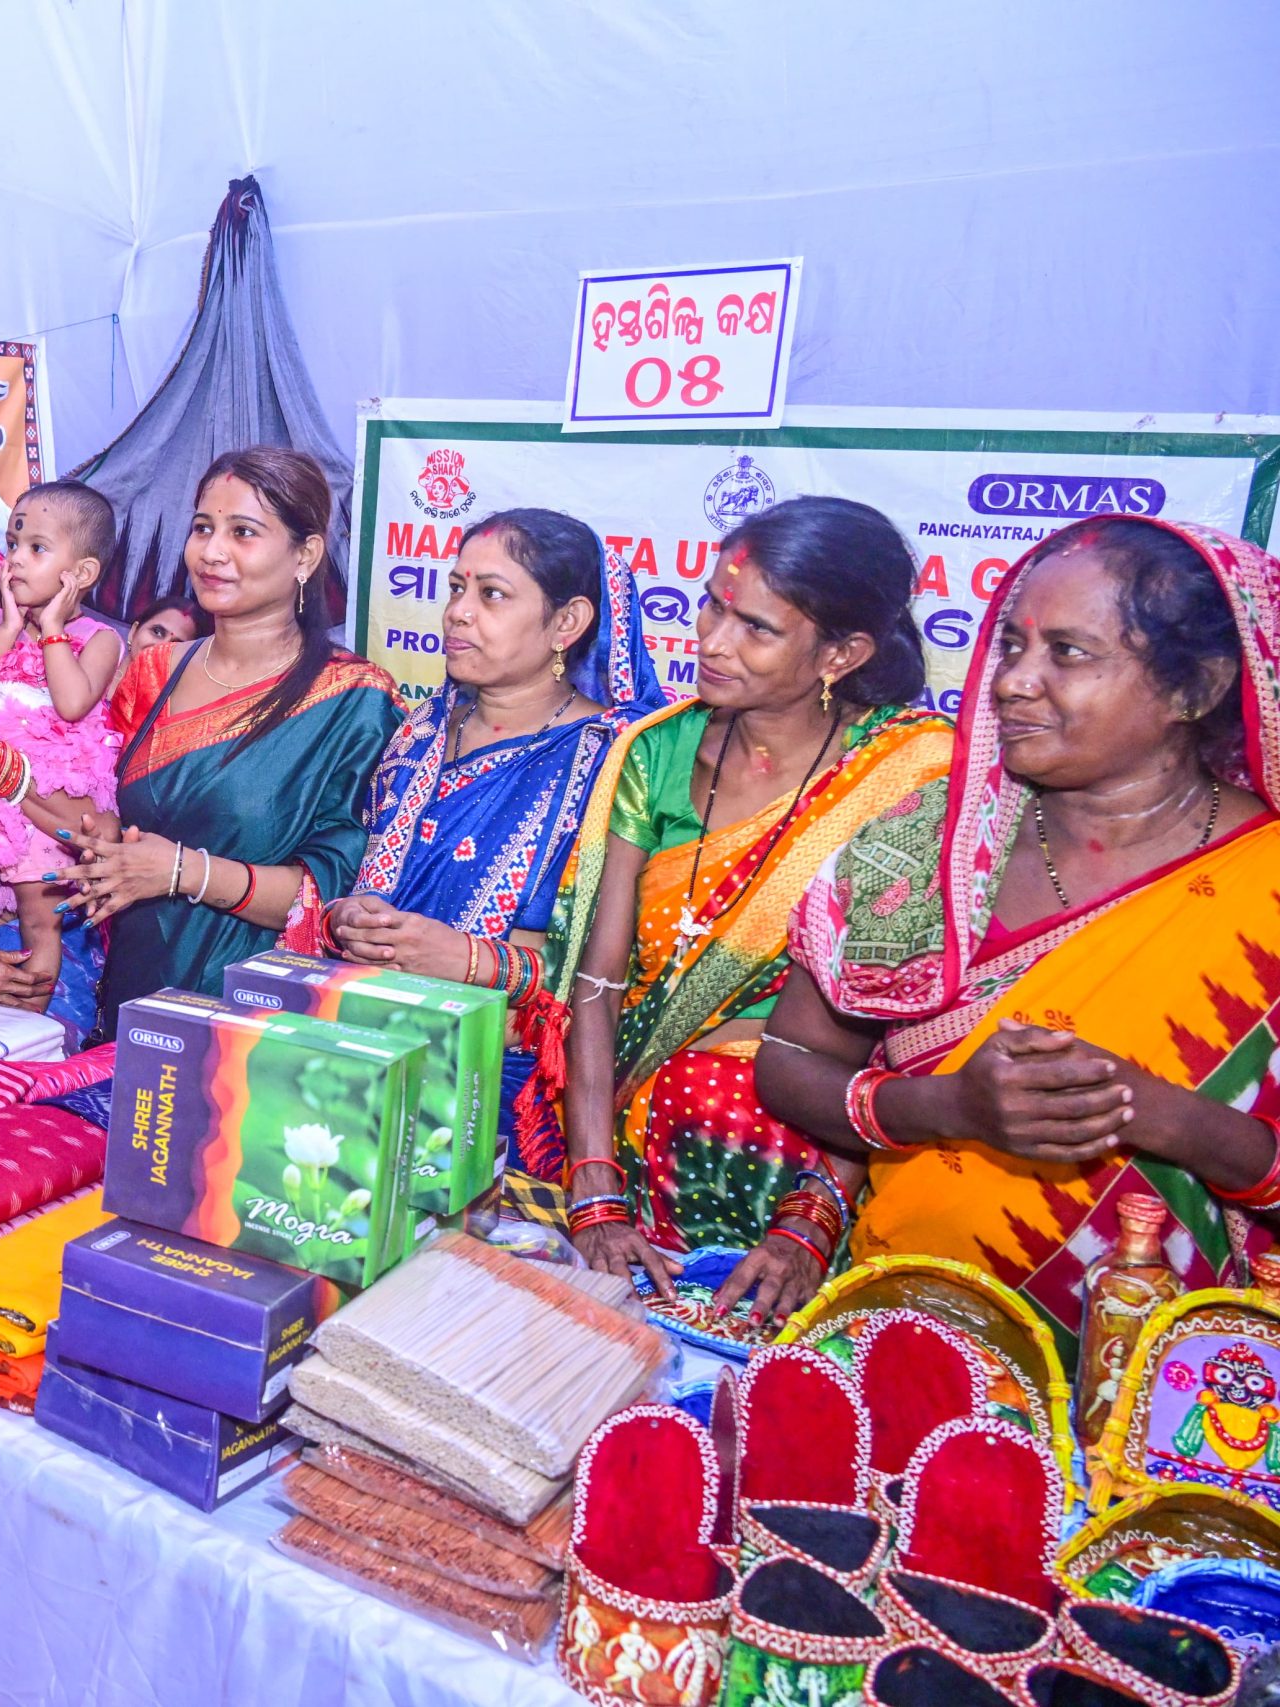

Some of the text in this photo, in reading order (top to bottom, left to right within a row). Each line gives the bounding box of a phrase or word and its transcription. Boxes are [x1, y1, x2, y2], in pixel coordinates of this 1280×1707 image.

[591, 283, 777, 352] ହସ୍ତଶିଳ୍ପ କକ୍ଷ
[426, 449, 465, 468] MISSION
[432, 463, 462, 477] SHAKTI
[982, 481, 1152, 515] ORMAS
[918, 523, 1044, 542] PANCHAYATRAJ
[605, 535, 658, 576] TA
[386, 629, 446, 655] PRO
[236, 991, 280, 1008] ORMAS
[133, 1030, 181, 1051] ORMAS
[131, 1088, 154, 1150] SHREE
[150, 1064, 178, 1186] JAGANNATH
[246, 1197, 353, 1245] Mogra
[136, 1238, 255, 1280] JAGANNATH
[149, 1253, 214, 1277] SHREE
[281, 1317, 305, 1341] SHREE
[221, 1422, 278, 1461] JAGANNATH
